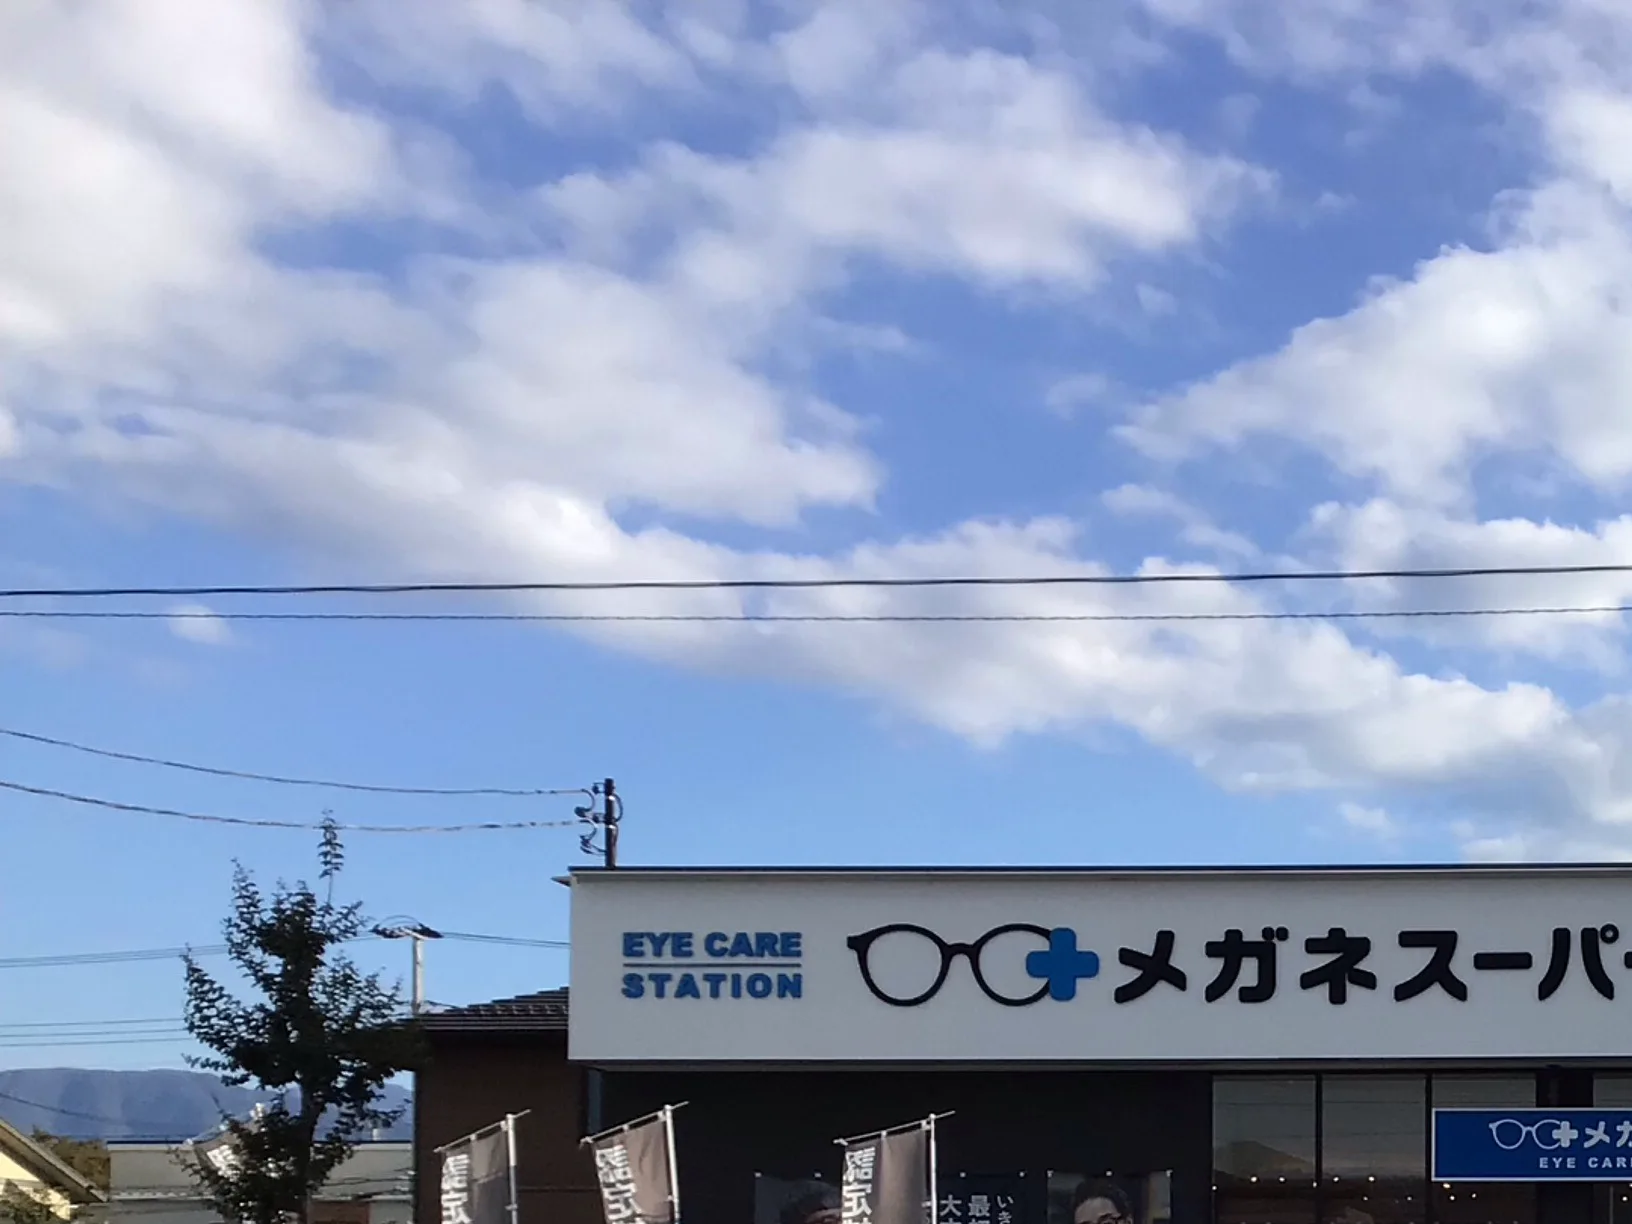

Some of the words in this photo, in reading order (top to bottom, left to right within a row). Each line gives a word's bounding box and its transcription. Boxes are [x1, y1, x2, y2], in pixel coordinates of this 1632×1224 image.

[622, 931, 693, 958] EYE
[705, 931, 803, 958] CARE
[621, 973, 803, 999] STATION
[1539, 1157, 1577, 1169] EYE
